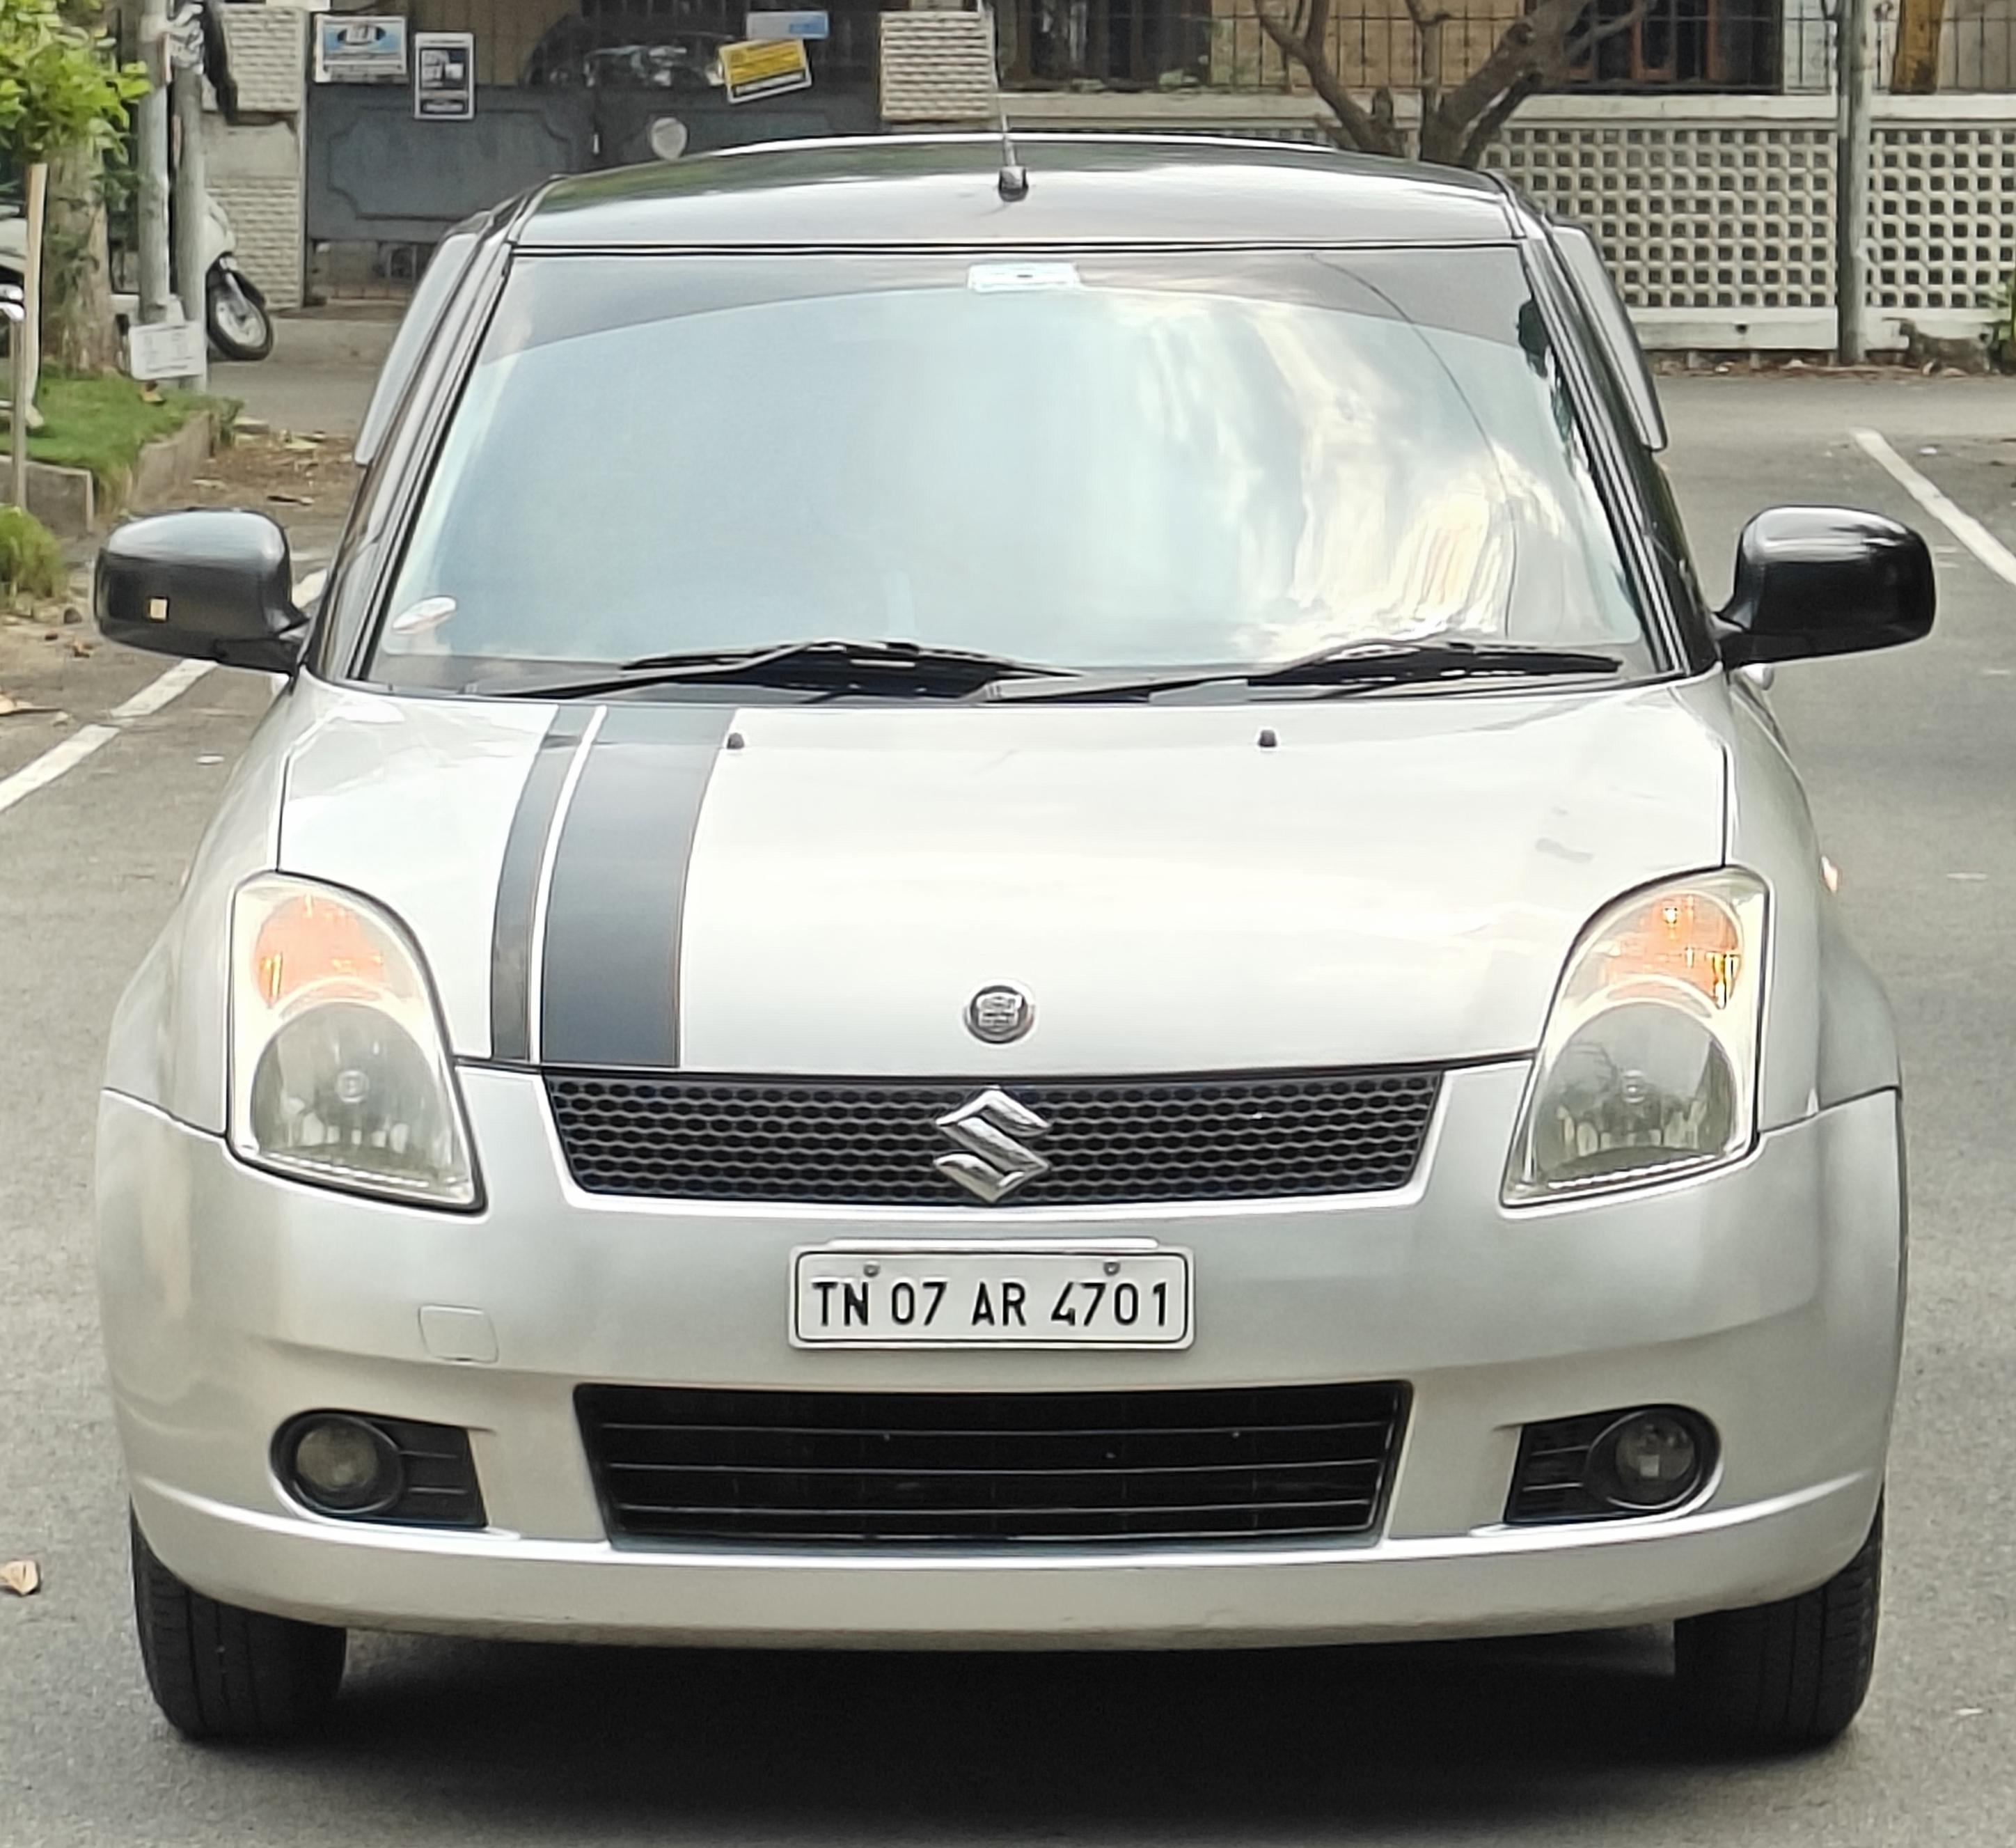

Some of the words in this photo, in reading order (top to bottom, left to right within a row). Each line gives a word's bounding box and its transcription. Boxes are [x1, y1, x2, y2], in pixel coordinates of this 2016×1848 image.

[812, 1281, 869, 1326] TN
[891, 1281, 947, 1326] 07
[971, 1281, 1027, 1326] AR
[1050, 1281, 1167, 1326] 4701
